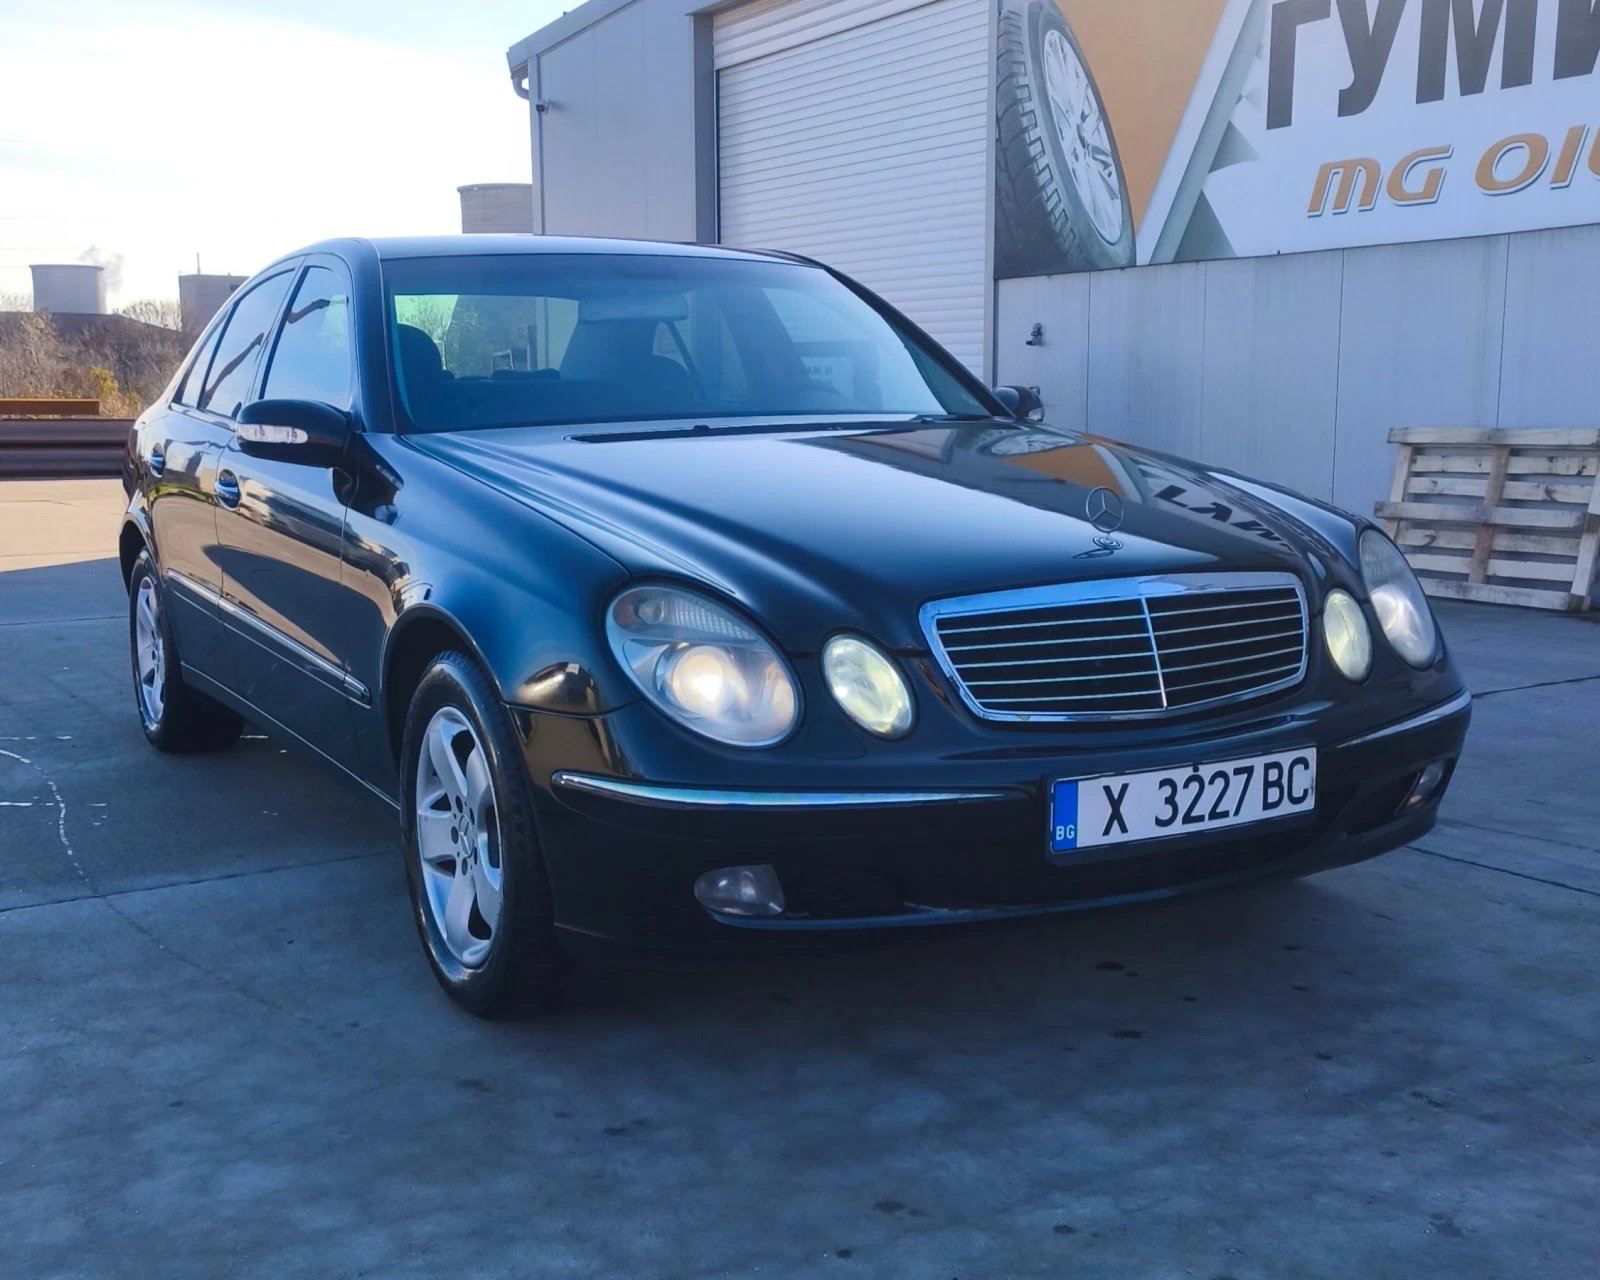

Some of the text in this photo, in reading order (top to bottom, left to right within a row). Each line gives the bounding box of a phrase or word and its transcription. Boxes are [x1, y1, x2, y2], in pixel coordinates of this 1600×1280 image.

[1474, 123, 1600, 196] OI
[1056, 824, 1075, 841] BG
[1101, 755, 1310, 837] X 3227 BC
